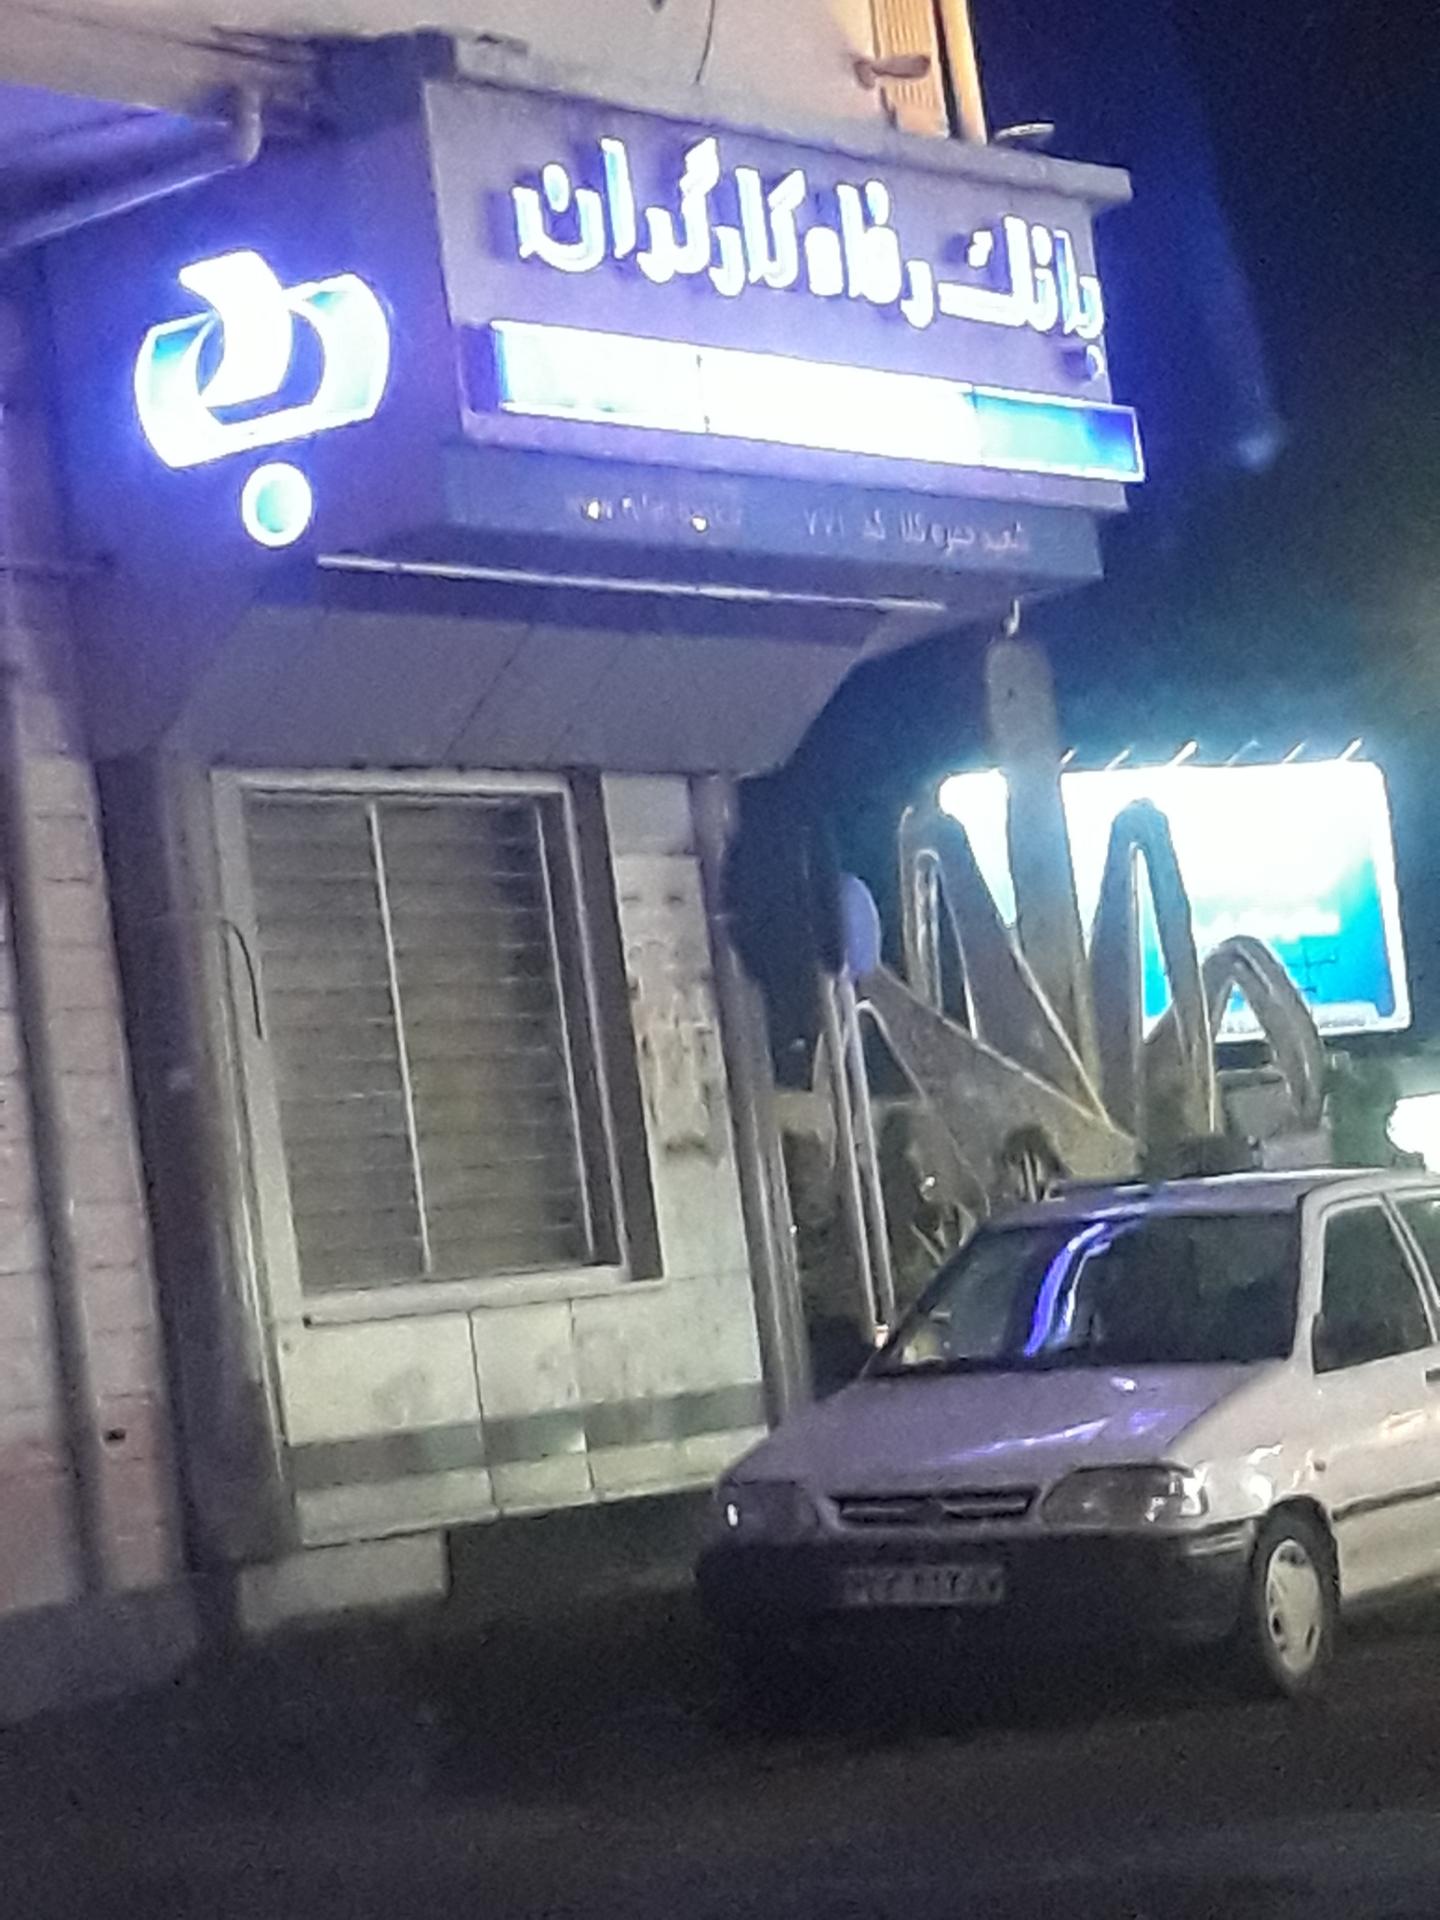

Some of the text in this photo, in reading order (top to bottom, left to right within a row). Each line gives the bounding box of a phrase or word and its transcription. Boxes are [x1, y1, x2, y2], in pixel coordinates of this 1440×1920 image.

[512, 137, 1106, 380] بانک رفاه کارگران
